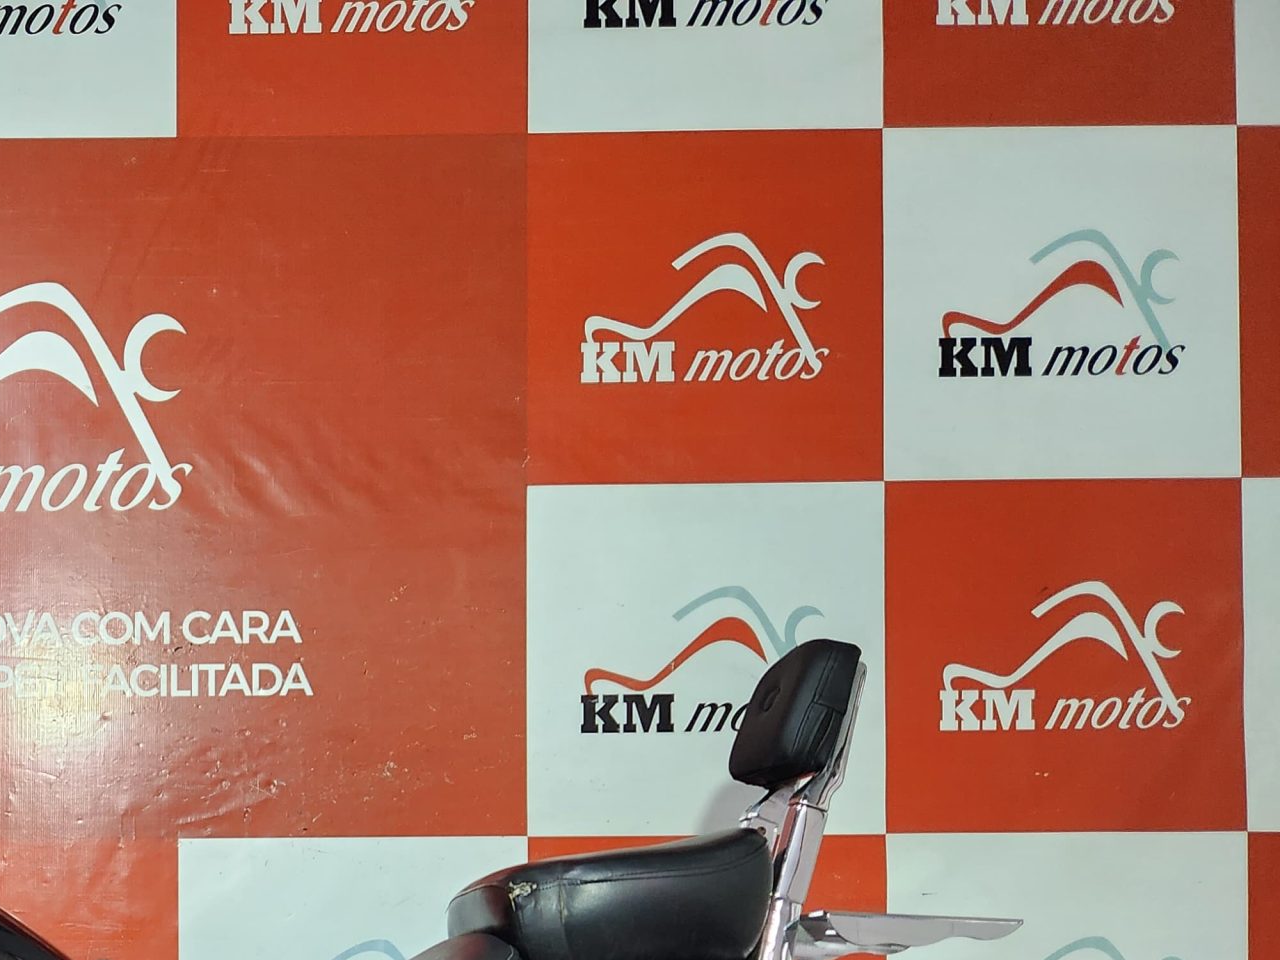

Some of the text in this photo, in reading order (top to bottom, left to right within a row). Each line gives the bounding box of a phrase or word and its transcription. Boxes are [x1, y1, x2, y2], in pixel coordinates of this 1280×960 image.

[229, 0, 474, 34] KM motos
[584, 0, 676, 28] KM
[936, 0, 1028, 25] KM
[581, 339, 829, 383] KM motos
[939, 337, 1185, 377] KM motos
[70, 610, 170, 645] COM
[181, 609, 303, 644] CARA
[581, 694, 674, 733] KM
[940, 686, 1191, 731] KM motos
